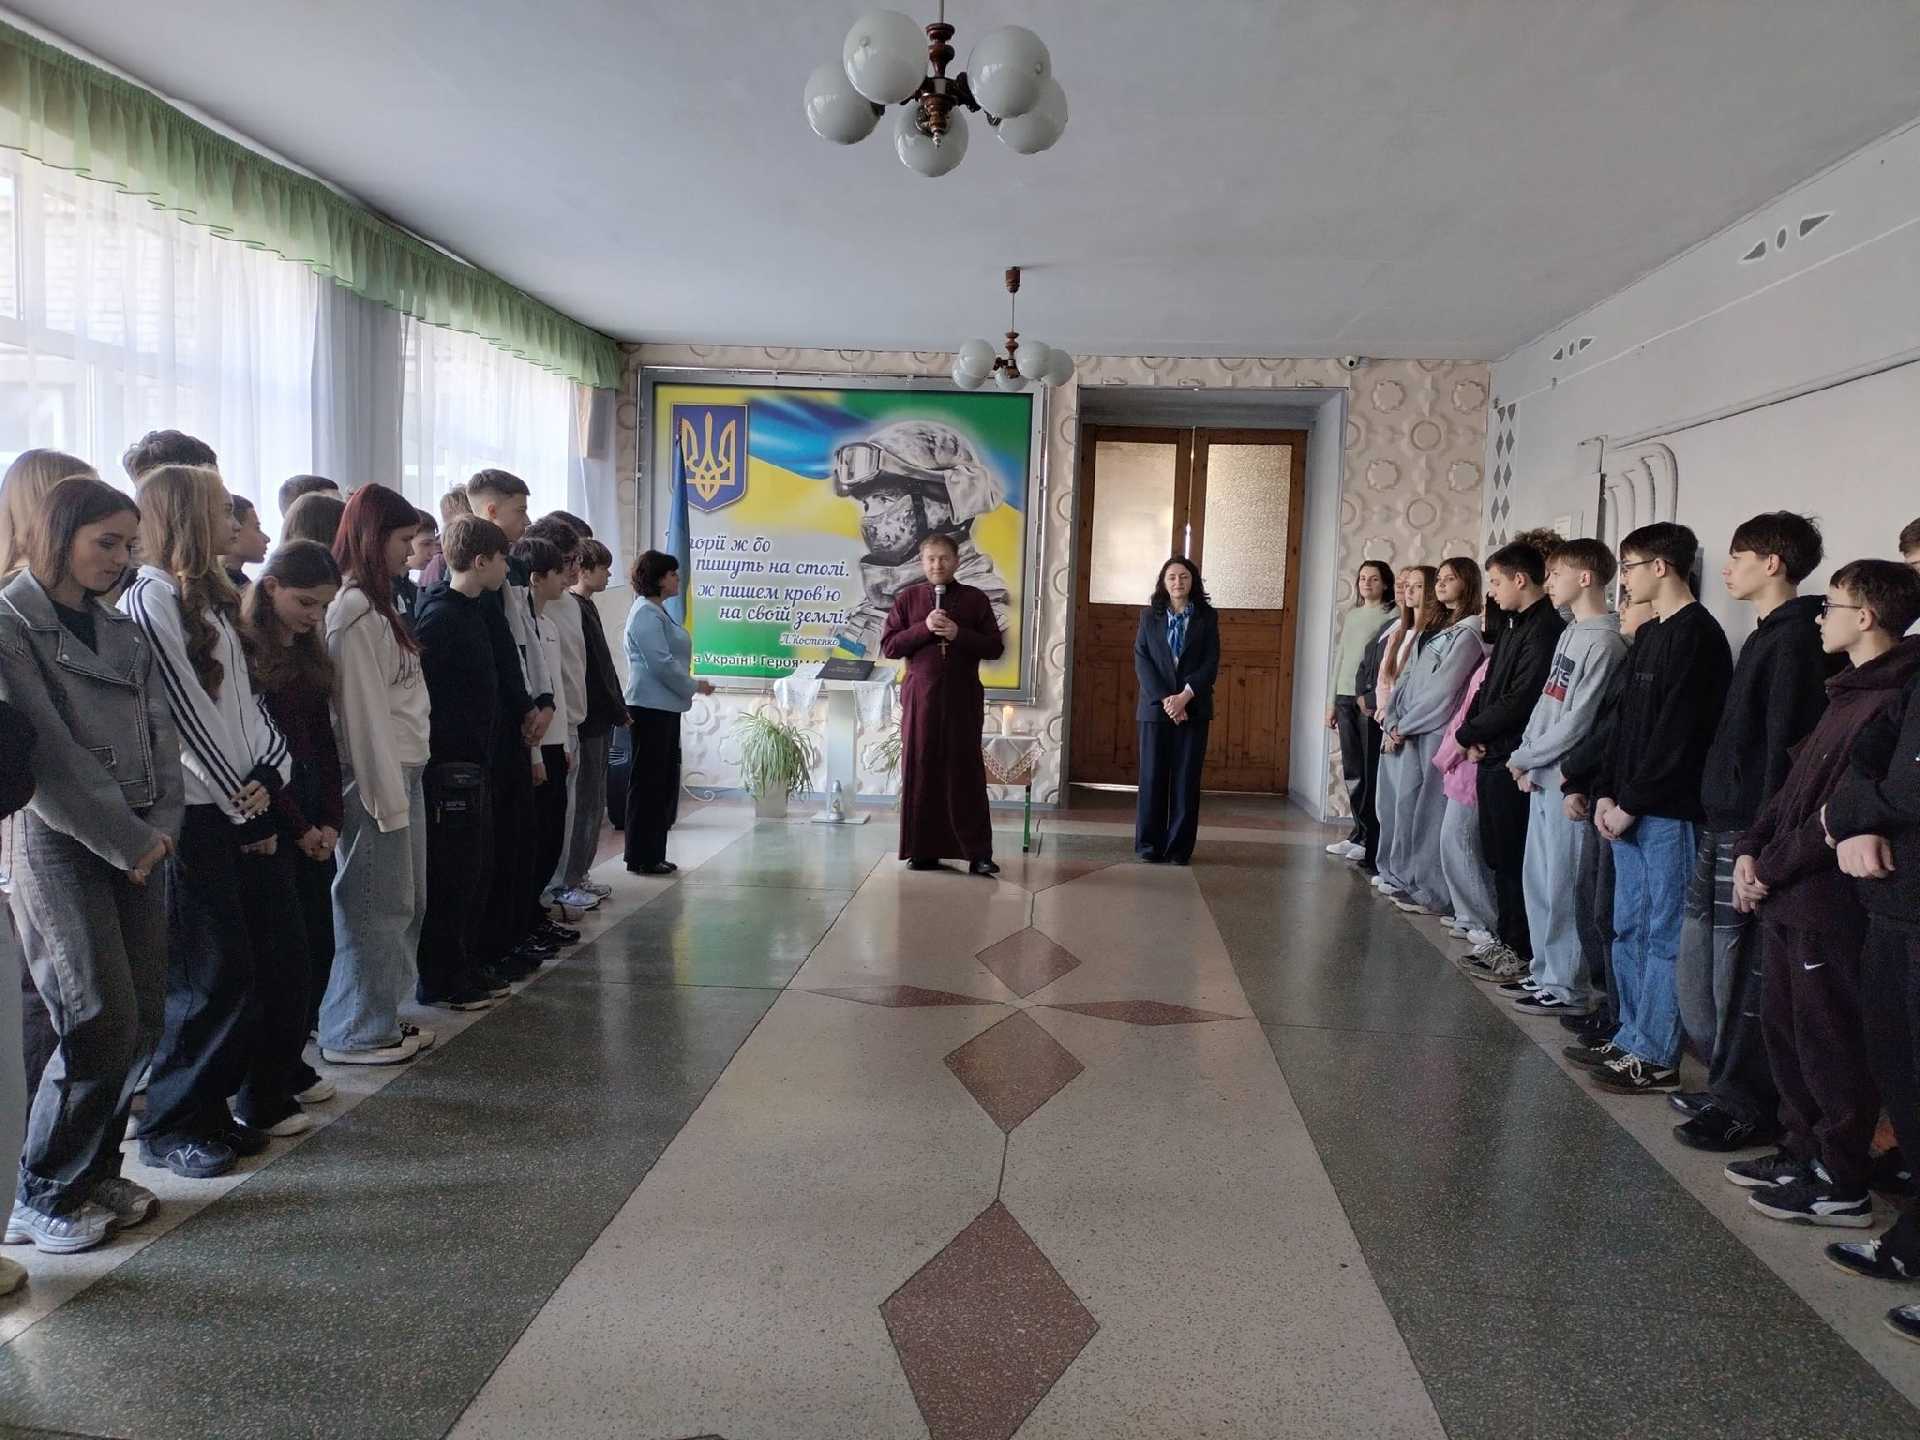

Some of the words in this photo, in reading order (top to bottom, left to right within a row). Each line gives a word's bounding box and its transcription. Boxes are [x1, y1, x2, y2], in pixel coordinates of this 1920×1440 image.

[730, 538, 749, 552] ж
[753, 536, 771, 552] бо
[696, 559, 764, 579] пишуть
[768, 561, 790, 574] на
[795, 561, 849, 576] столі.
[697, 584, 715, 597] ж
[720, 585, 779, 599] пишем
[784, 585, 841, 606] кров'ю
[719, 606, 741, 619] на
[747, 605, 791, 622] своїй
